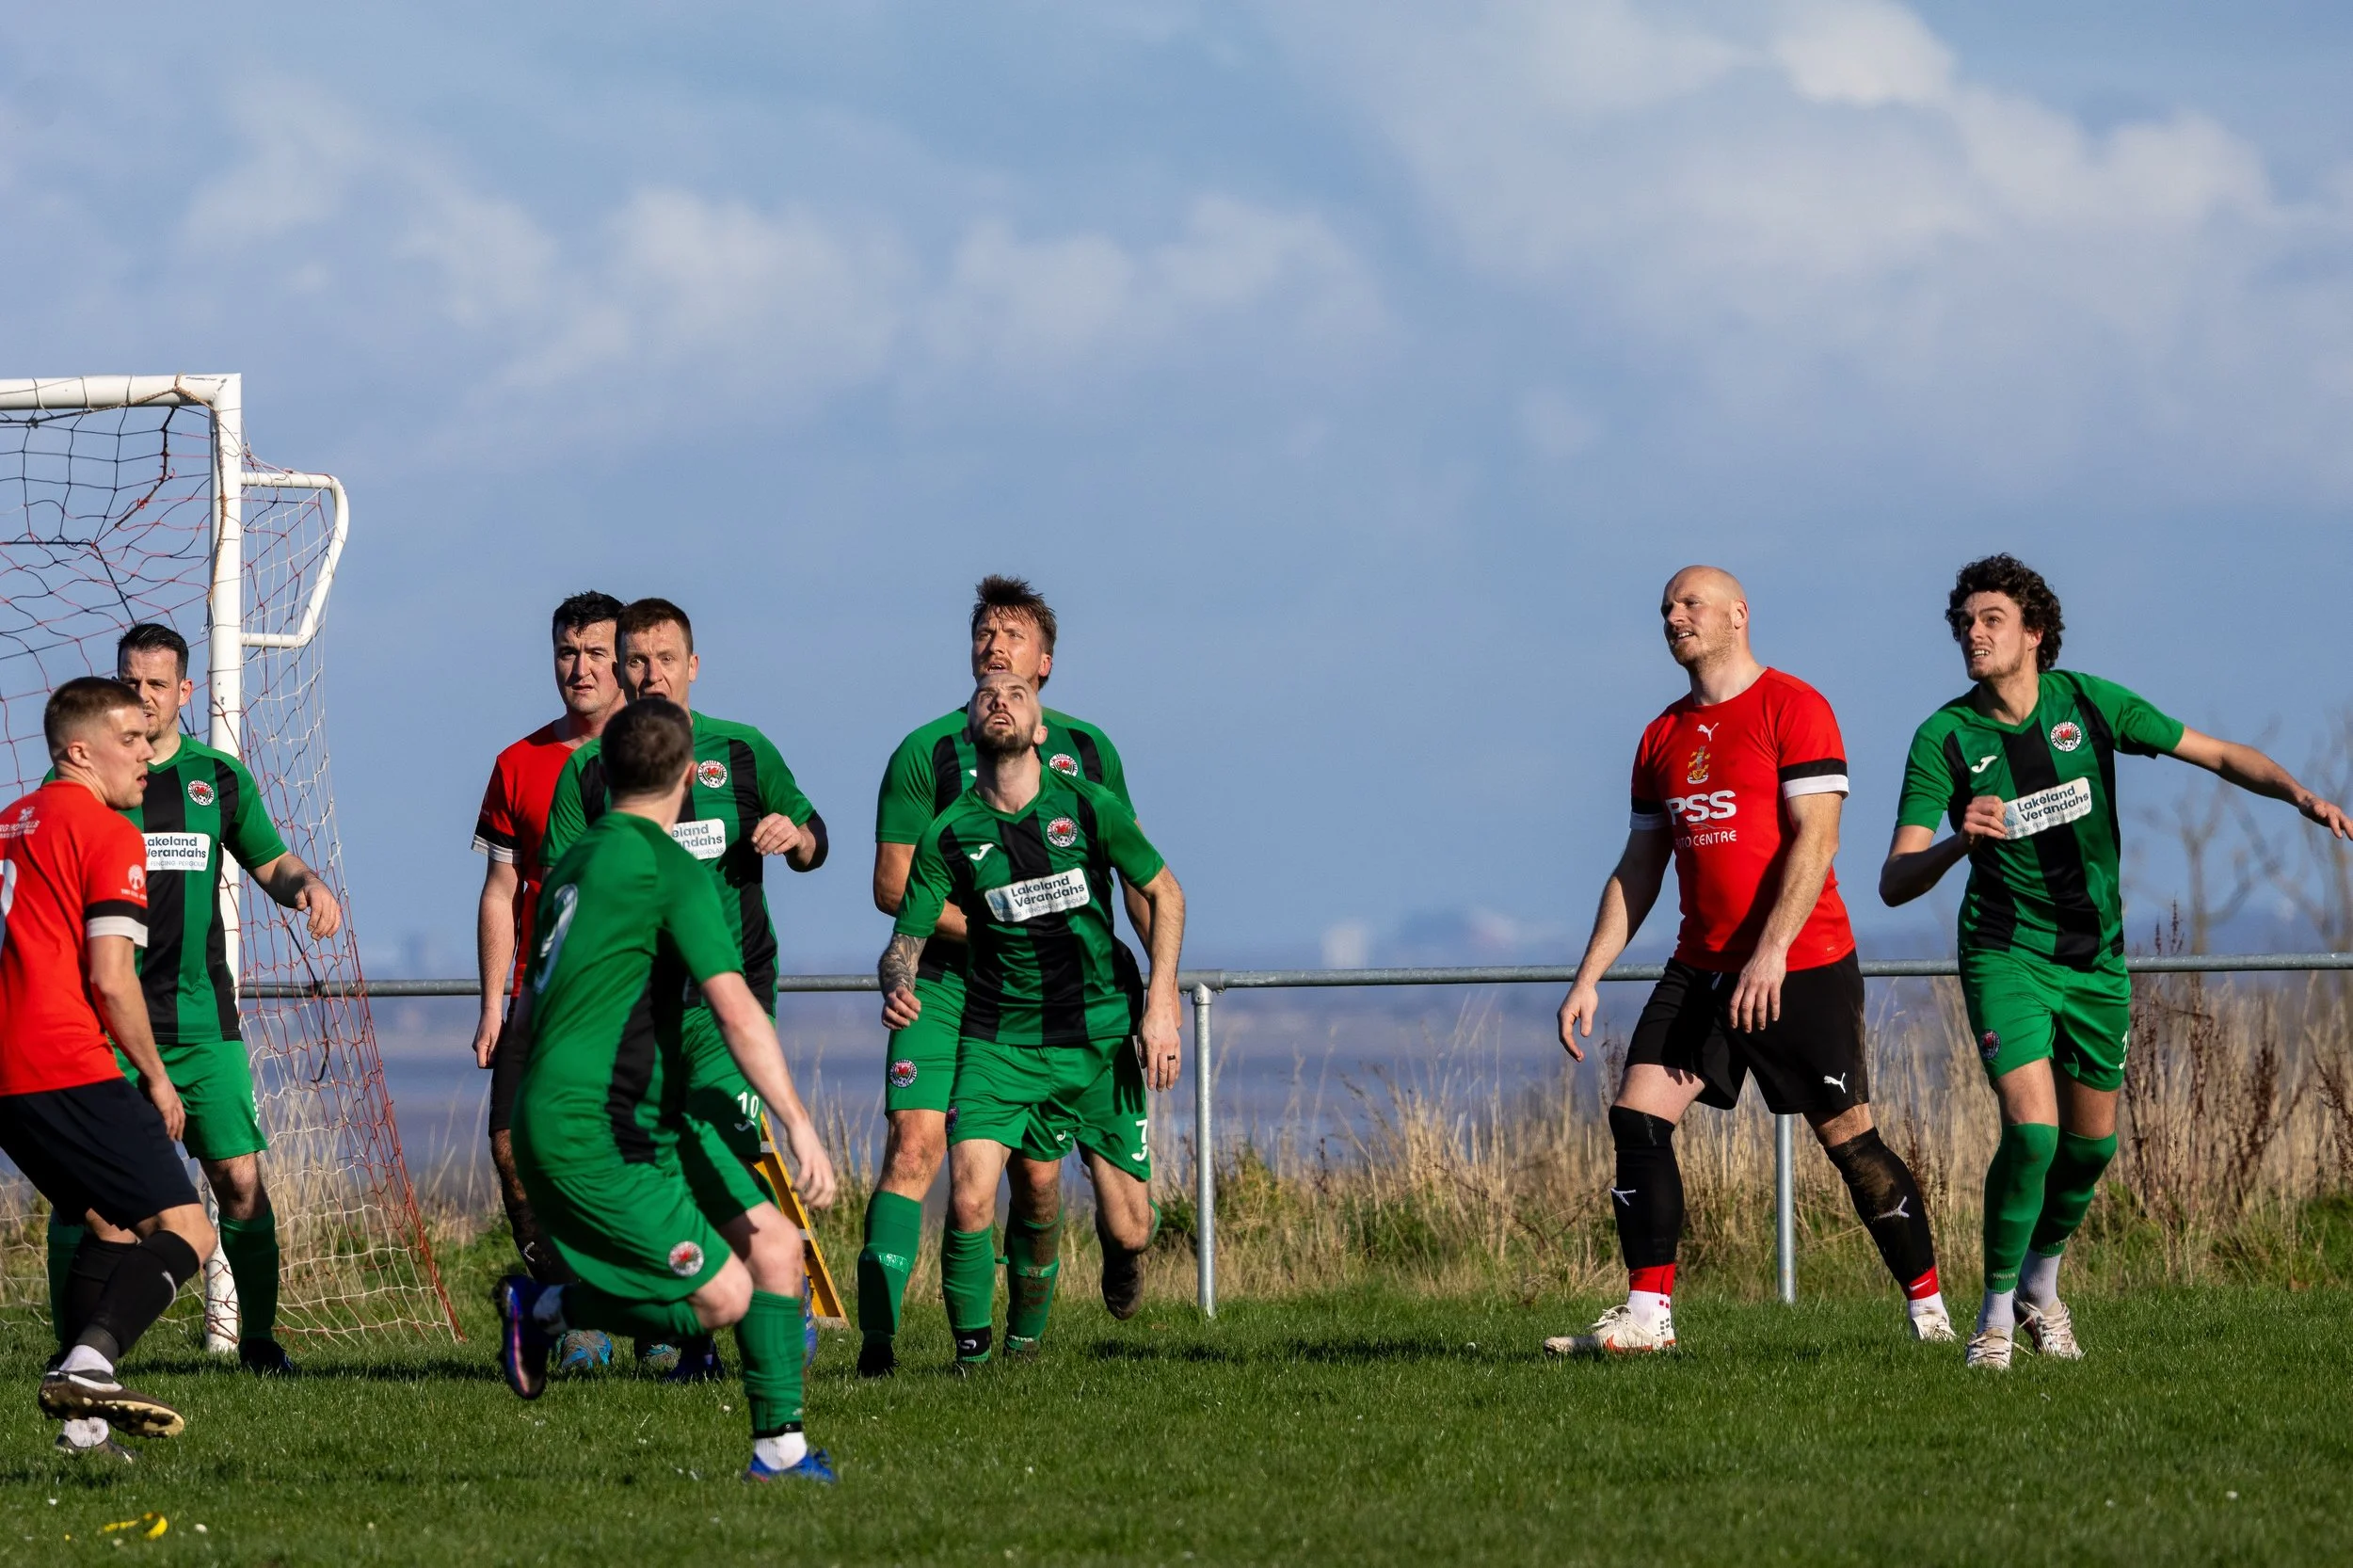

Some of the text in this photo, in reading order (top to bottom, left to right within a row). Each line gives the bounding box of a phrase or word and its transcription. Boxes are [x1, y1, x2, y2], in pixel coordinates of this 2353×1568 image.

[1665, 790, 1737, 825] PSS
[2017, 785, 2076, 812] Lakeland
[2021, 792, 2089, 823] Verandahs
[672, 824, 709, 838] eland
[1693, 829, 1737, 847] CENTRE
[1011, 875, 1070, 898] Lakeland
[1015, 884, 1085, 908] Verandahs
[737, 1091, 760, 1119] 10
[1135, 1118, 1148, 1144] 7
